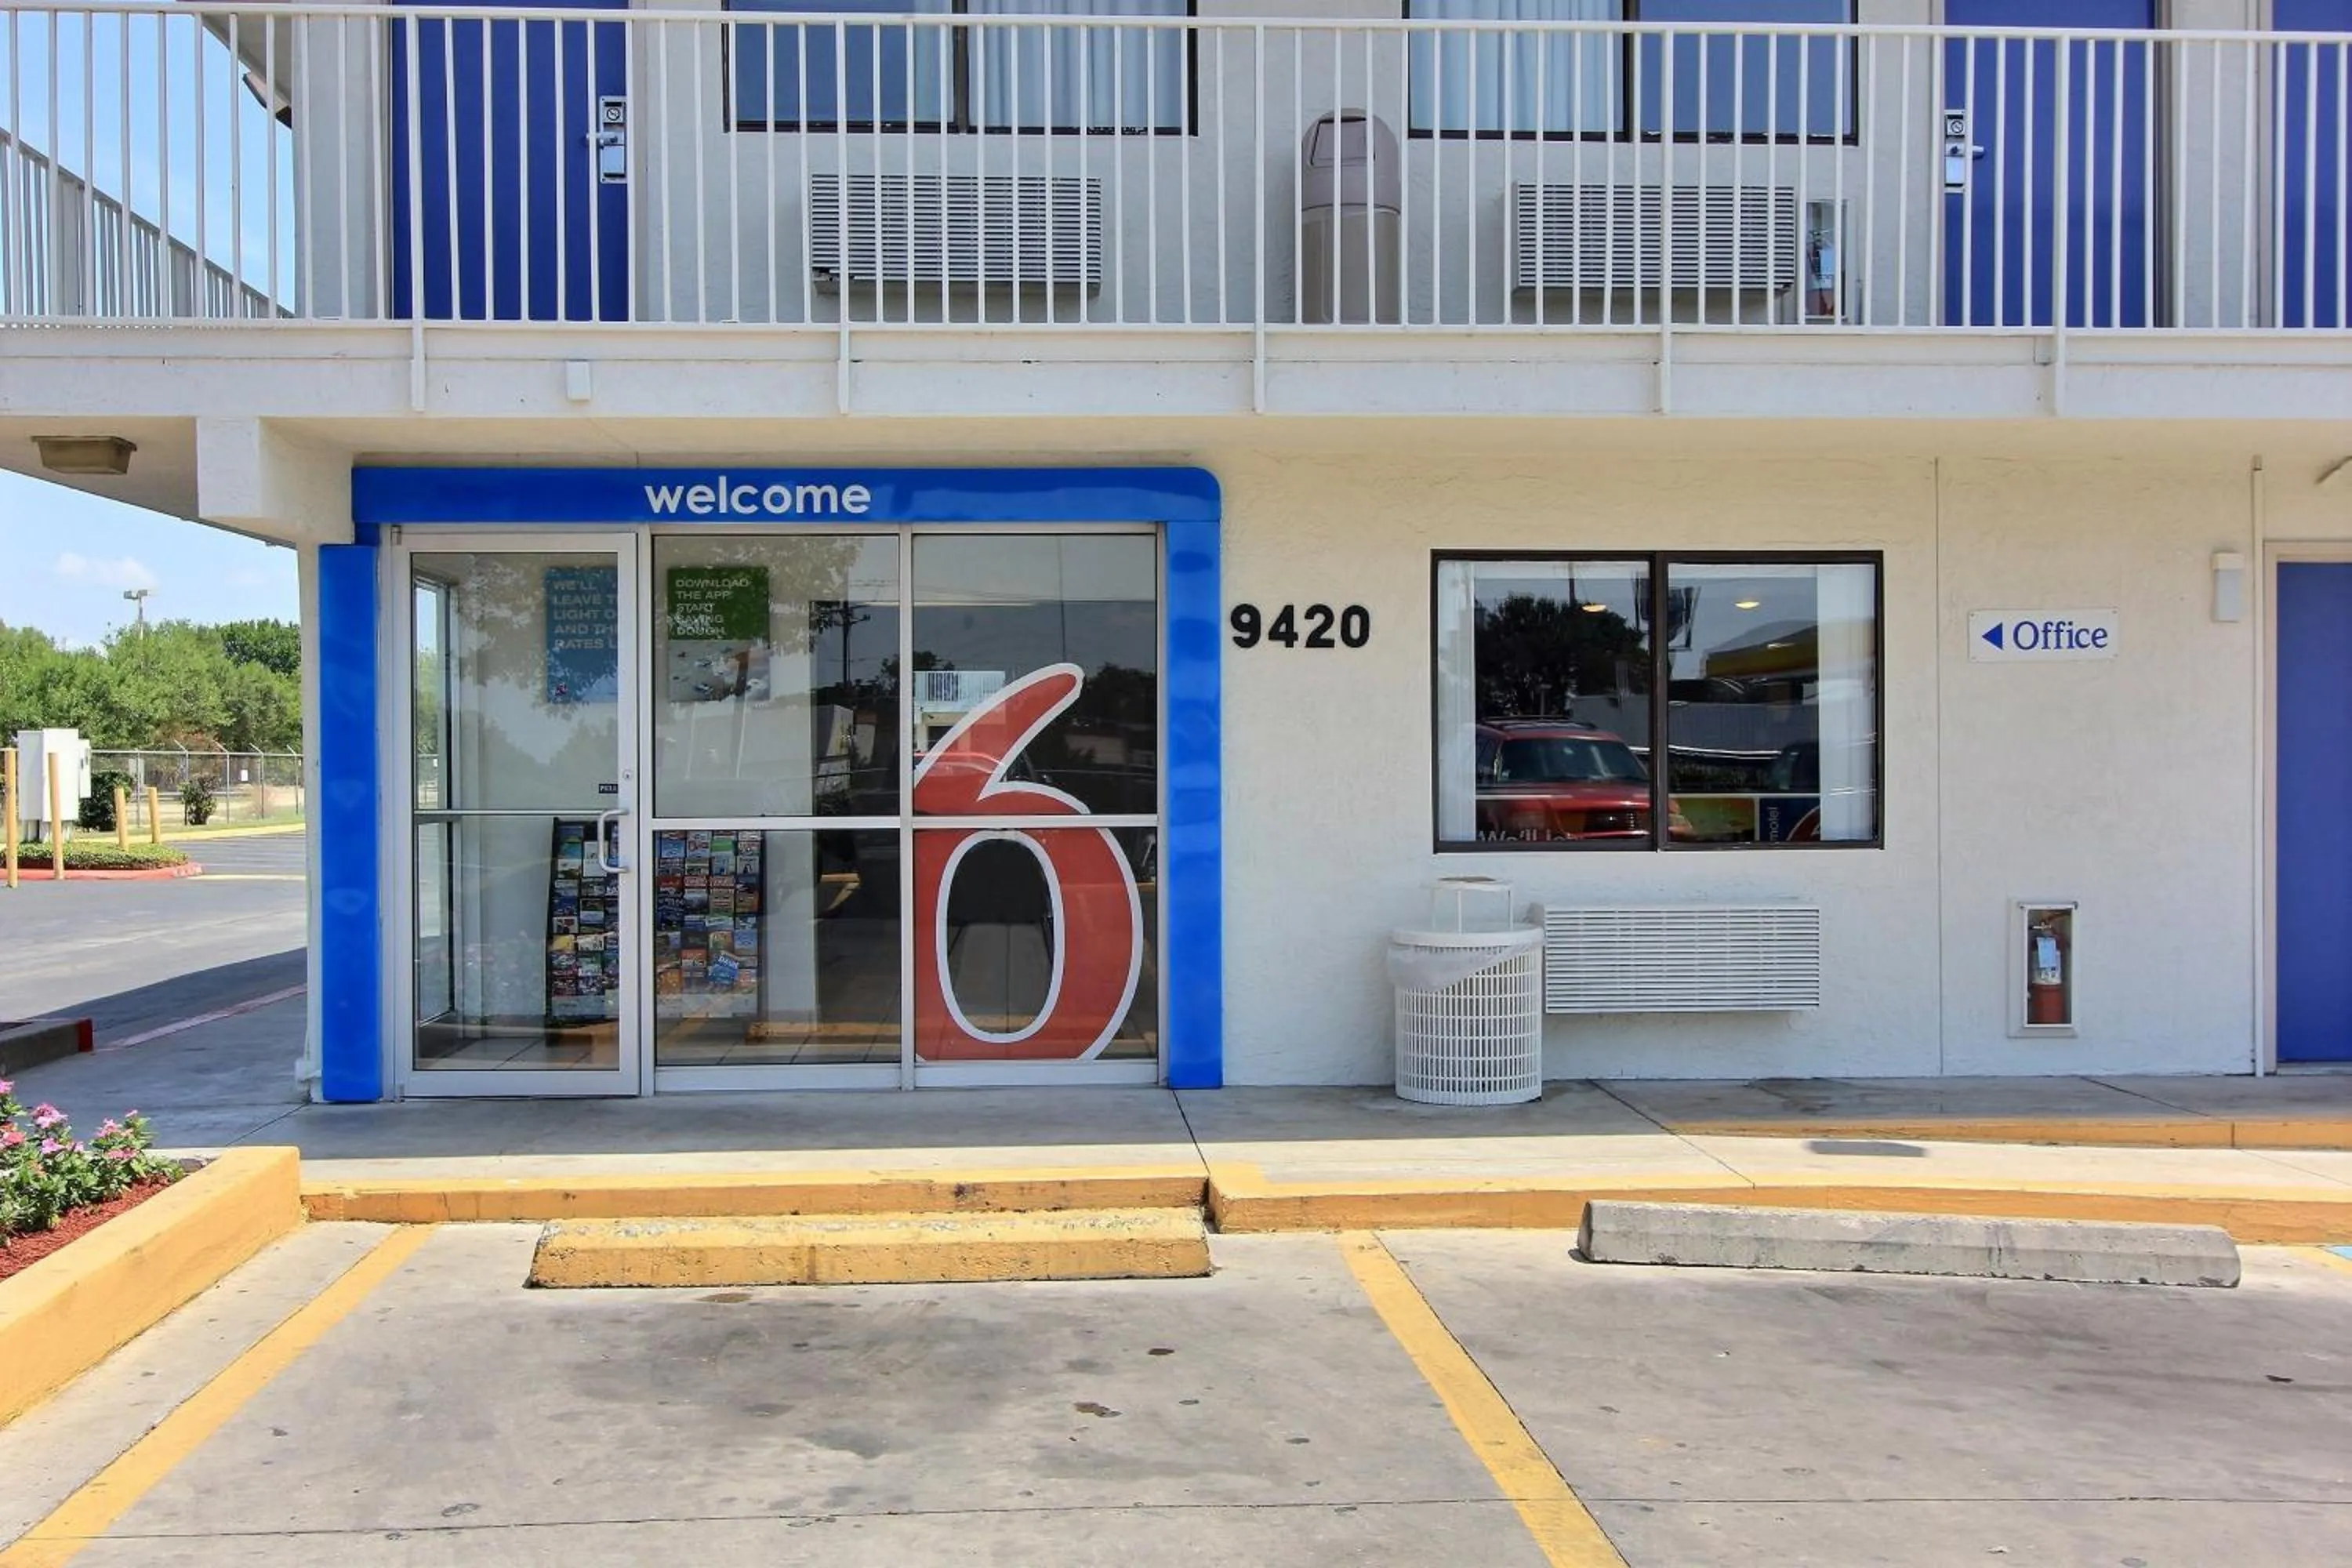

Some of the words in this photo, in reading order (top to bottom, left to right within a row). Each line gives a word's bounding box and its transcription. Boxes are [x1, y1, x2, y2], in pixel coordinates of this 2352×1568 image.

[644, 475, 871, 514] welcome
[675, 578, 750, 588] DOWNLOAD
[553, 594, 601, 604] LEAVE
[676, 590, 702, 600] THE
[677, 603, 714, 613] START
[554, 609, 601, 620] LIGHT
[676, 613, 724, 623] SAVING
[554, 624, 589, 634] AND
[1230, 604, 1370, 648] 9420
[2013, 620, 2108, 650] Office
[554, 639, 604, 649] RATES
[914, 662, 1144, 1061] 6
